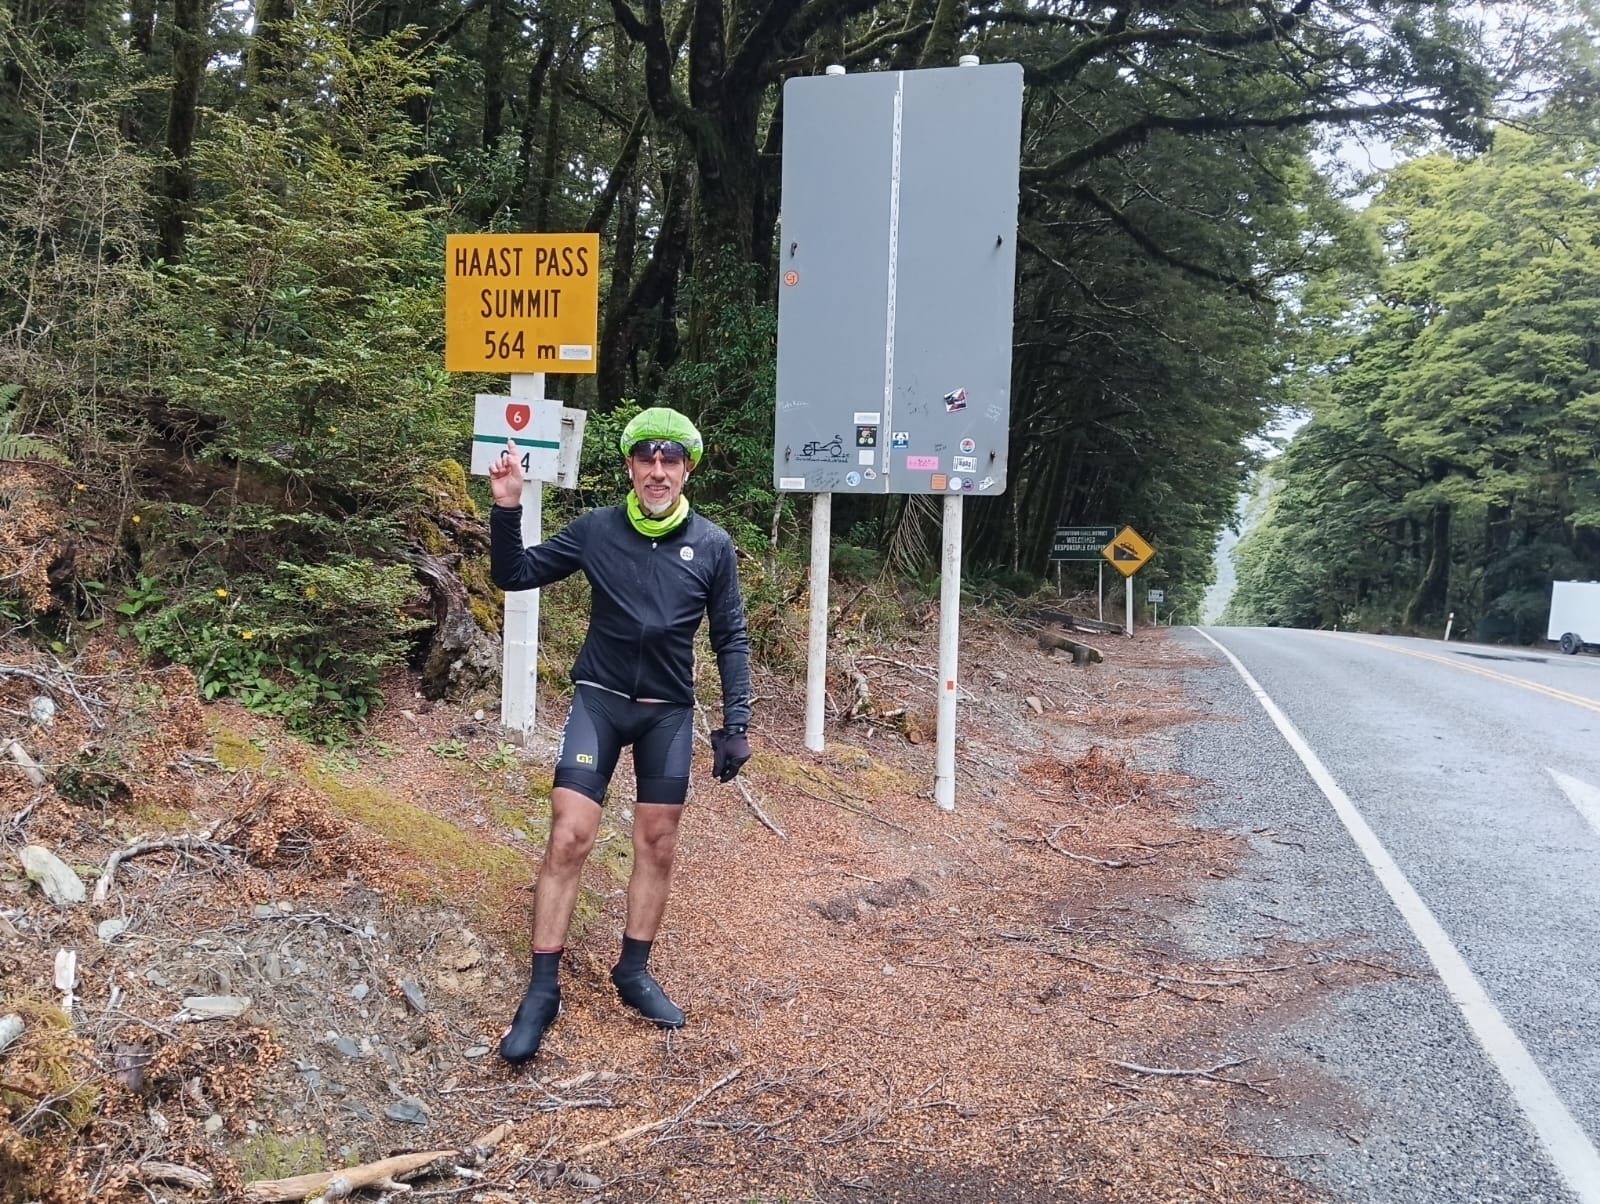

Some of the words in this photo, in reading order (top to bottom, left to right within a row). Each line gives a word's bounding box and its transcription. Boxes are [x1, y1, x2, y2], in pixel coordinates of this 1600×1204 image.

[455, 247, 523, 277] HAAST
[535, 247, 588, 277] PASS
[480, 288, 561, 318] SUMMIT
[484, 330, 525, 360] 564
[537, 344, 556, 360] m
[513, 411, 522, 424] 6
